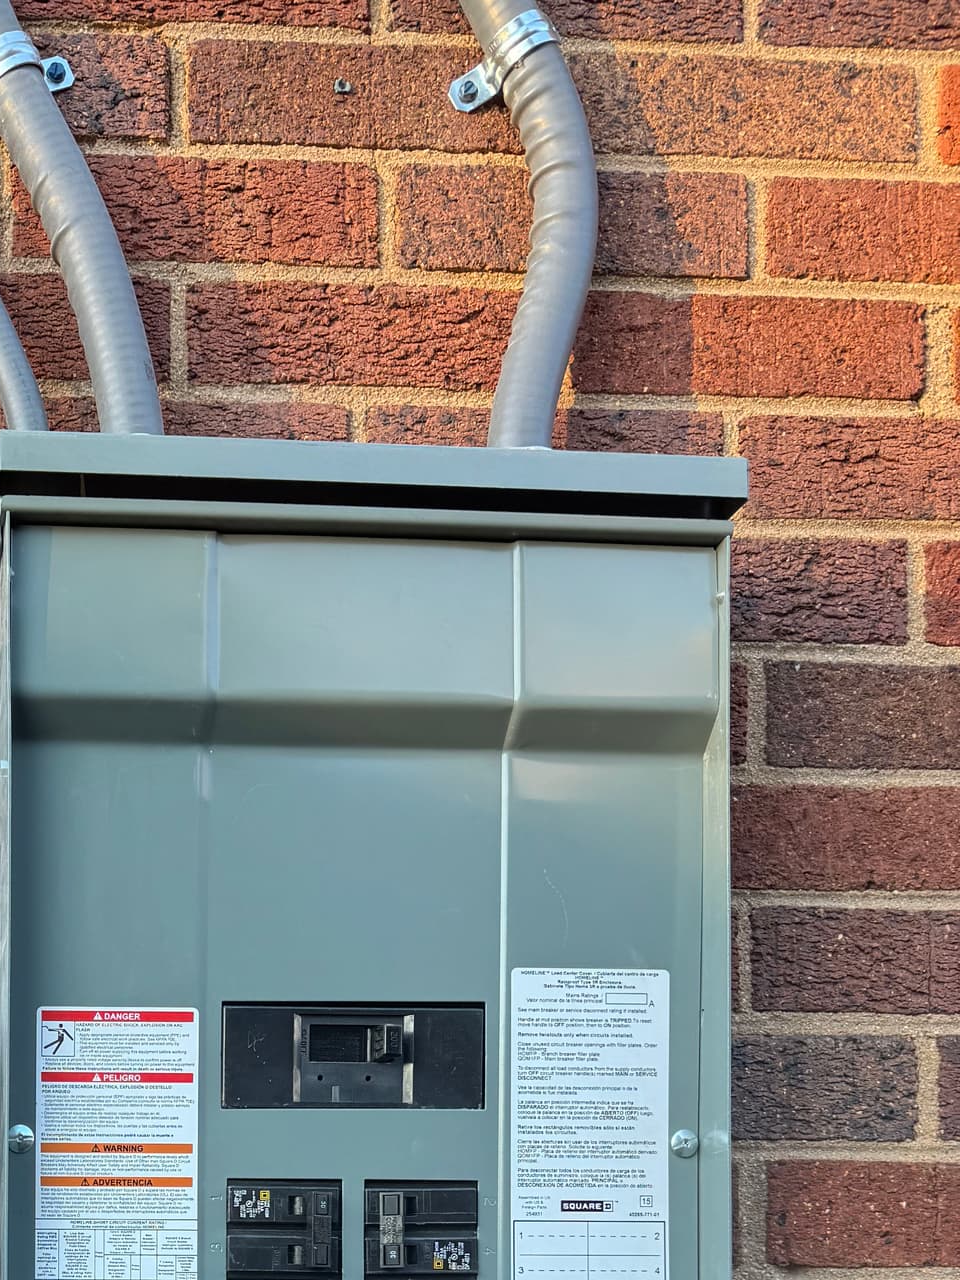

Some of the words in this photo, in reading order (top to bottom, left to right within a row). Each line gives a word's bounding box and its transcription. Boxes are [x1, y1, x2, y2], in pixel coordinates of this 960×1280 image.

[648, 1000, 655, 1008] A
[104, 1013, 141, 1021] DANGER
[103, 1074, 141, 1082] PELIGRO
[103, 1144, 144, 1153] WARNING
[93, 1179, 153, 1187] ADVERTENCIA
[483, 1197, 497, 1207] 2
[519, 1231, 523, 1240] 1
[654, 1231, 661, 1241] 2
[210, 1242, 223, 1253] 3
[485, 1247, 496, 1256] 4
[517, 1266, 525, 1275] 3
[654, 1266, 661, 1275] 4
